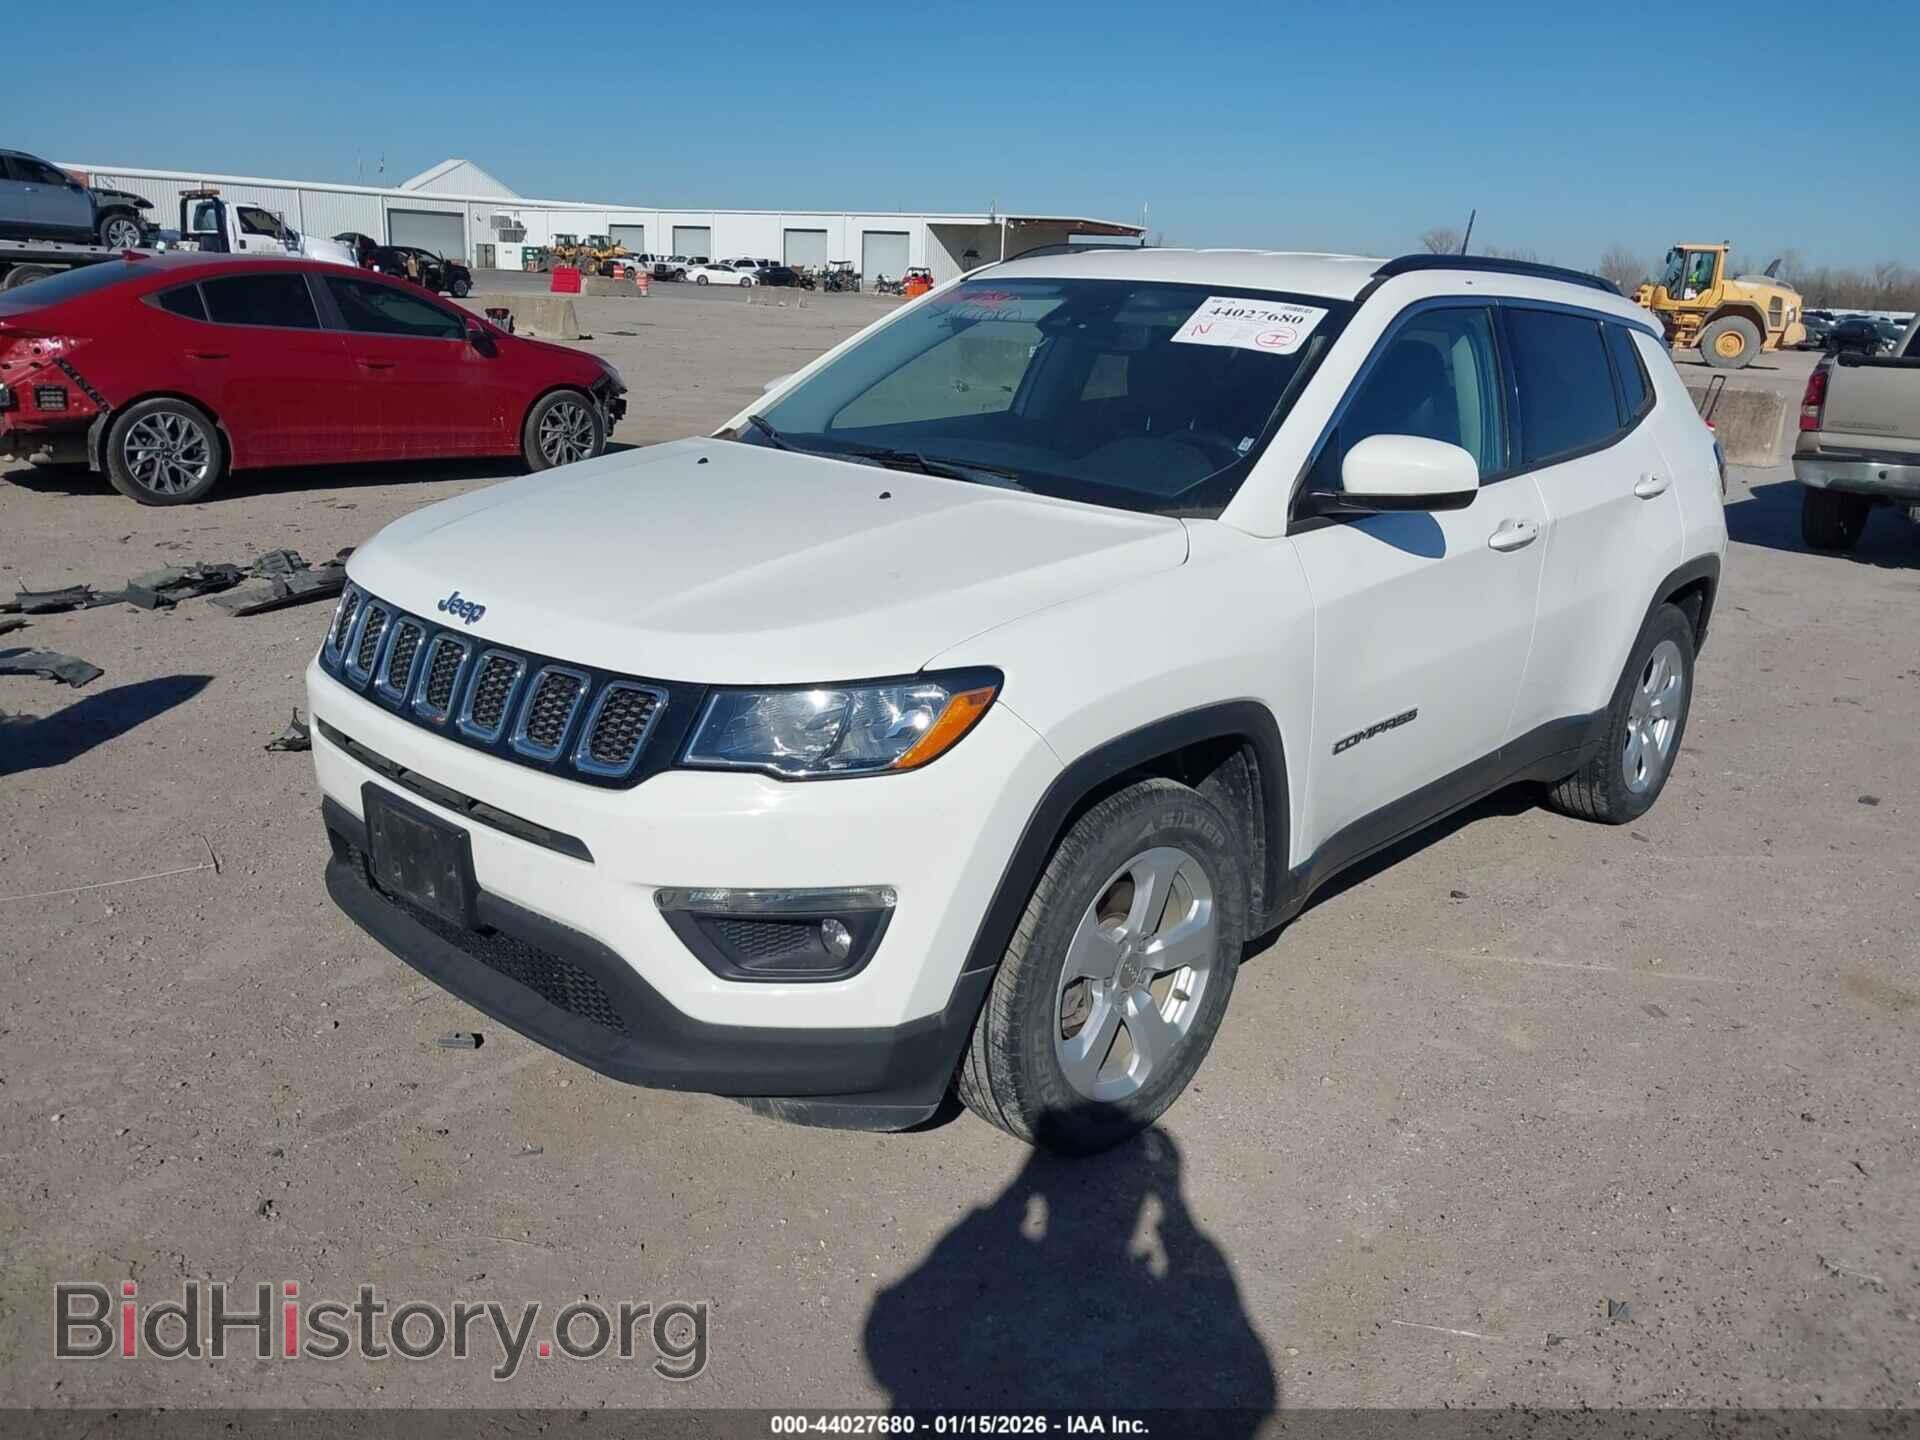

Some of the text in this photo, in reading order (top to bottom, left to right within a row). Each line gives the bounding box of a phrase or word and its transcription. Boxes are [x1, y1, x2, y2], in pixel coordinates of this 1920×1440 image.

[1208, 305, 1305, 325] 44027680
[1190, 322, 1216, 337] N
[437, 590, 486, 625] Jeep
[1332, 707, 1418, 756] COMPASS
